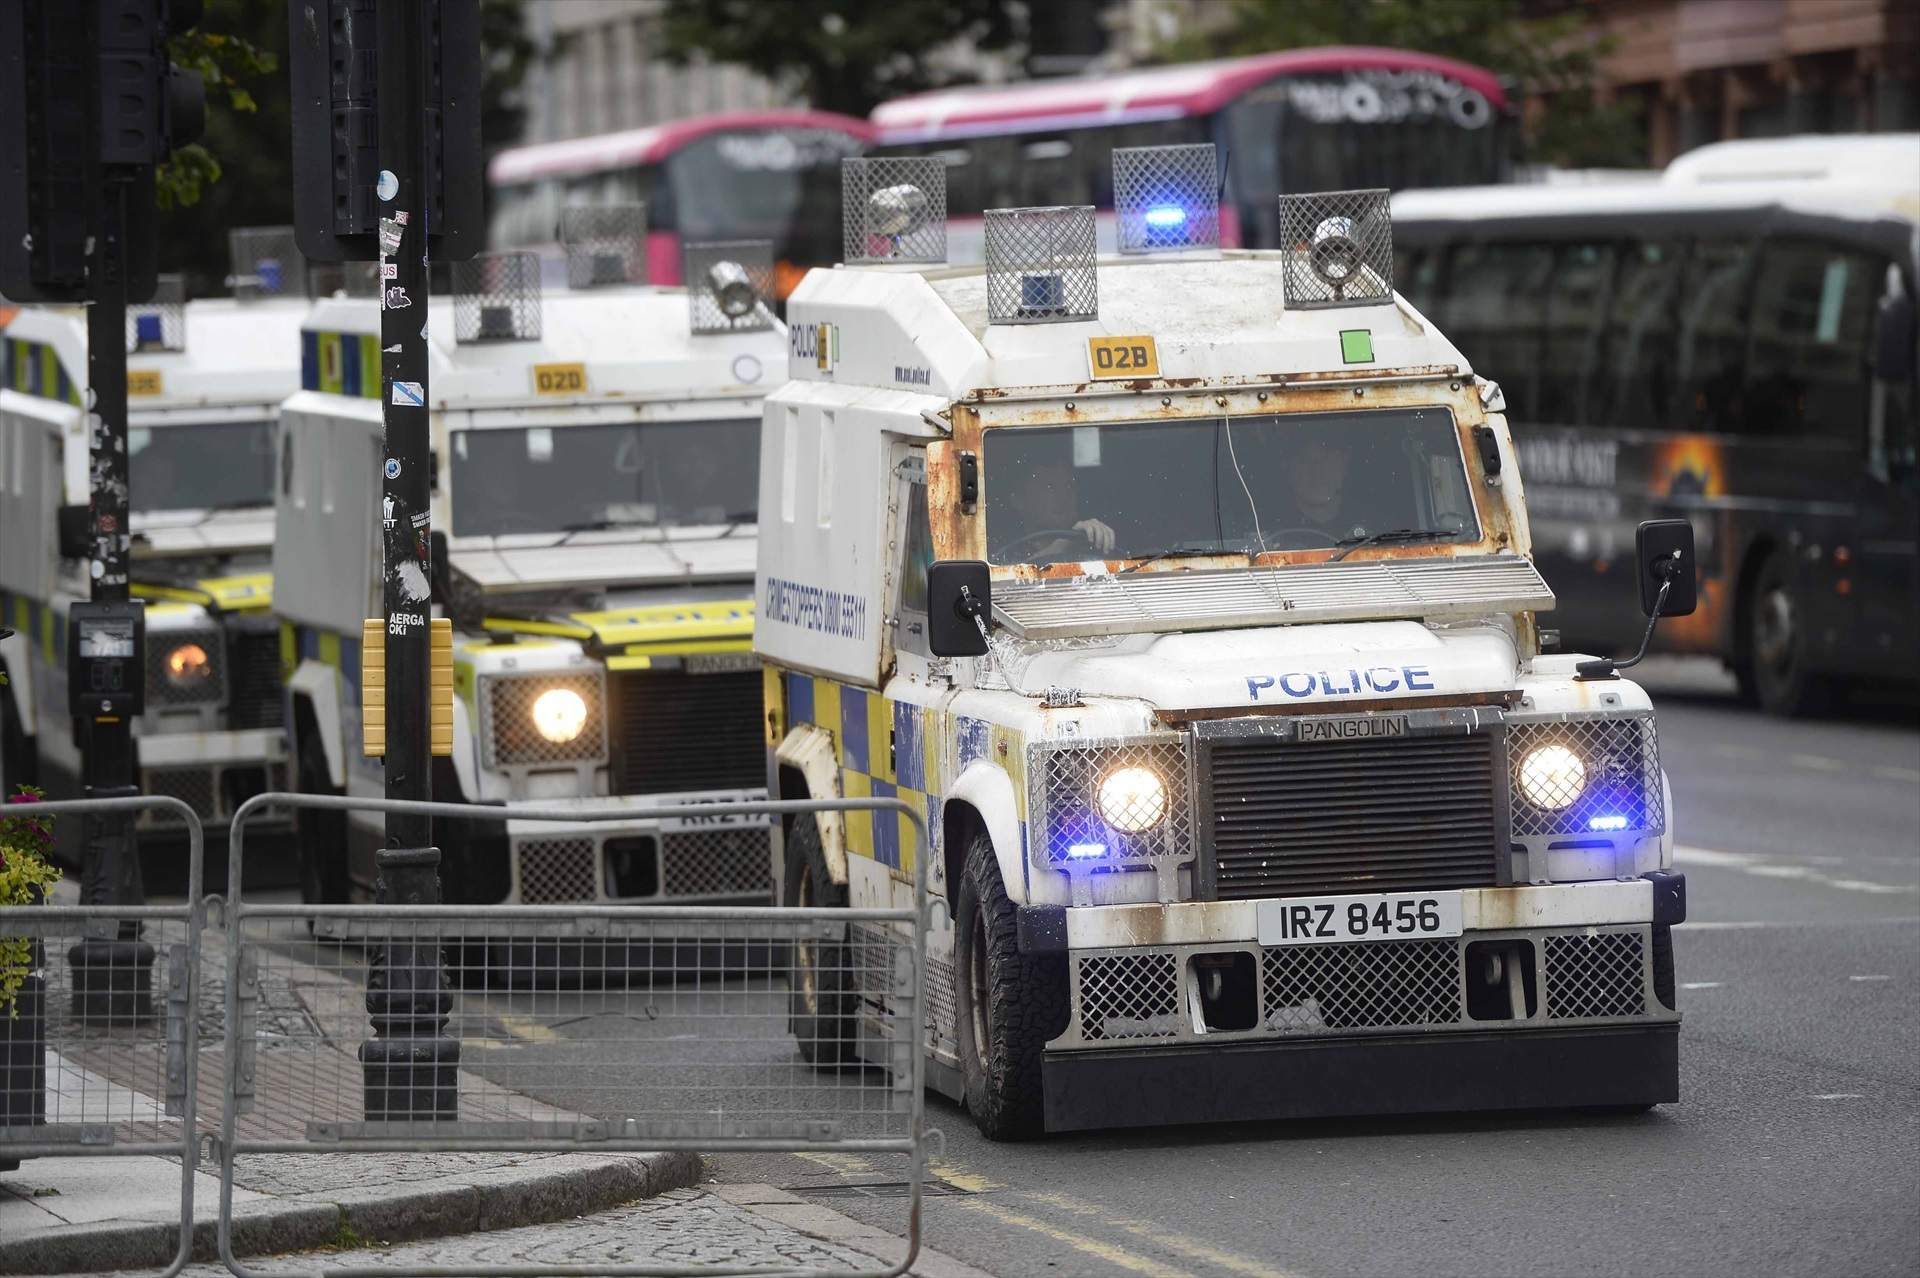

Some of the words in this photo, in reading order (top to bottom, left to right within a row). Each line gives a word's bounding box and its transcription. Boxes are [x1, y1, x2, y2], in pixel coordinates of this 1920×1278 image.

[1096, 346, 1148, 369] 02B
[390, 612, 425, 626] AERGA
[766, 577, 823, 632] CRIMESTOPPERS
[825, 591, 841, 635] 0800
[842, 594, 865, 641] 555111
[1245, 666, 1434, 700] POLICE
[1302, 718, 1401, 740] PANGOLIN
[1280, 903, 1336, 939] IRZ
[1347, 899, 1440, 935] 8456
